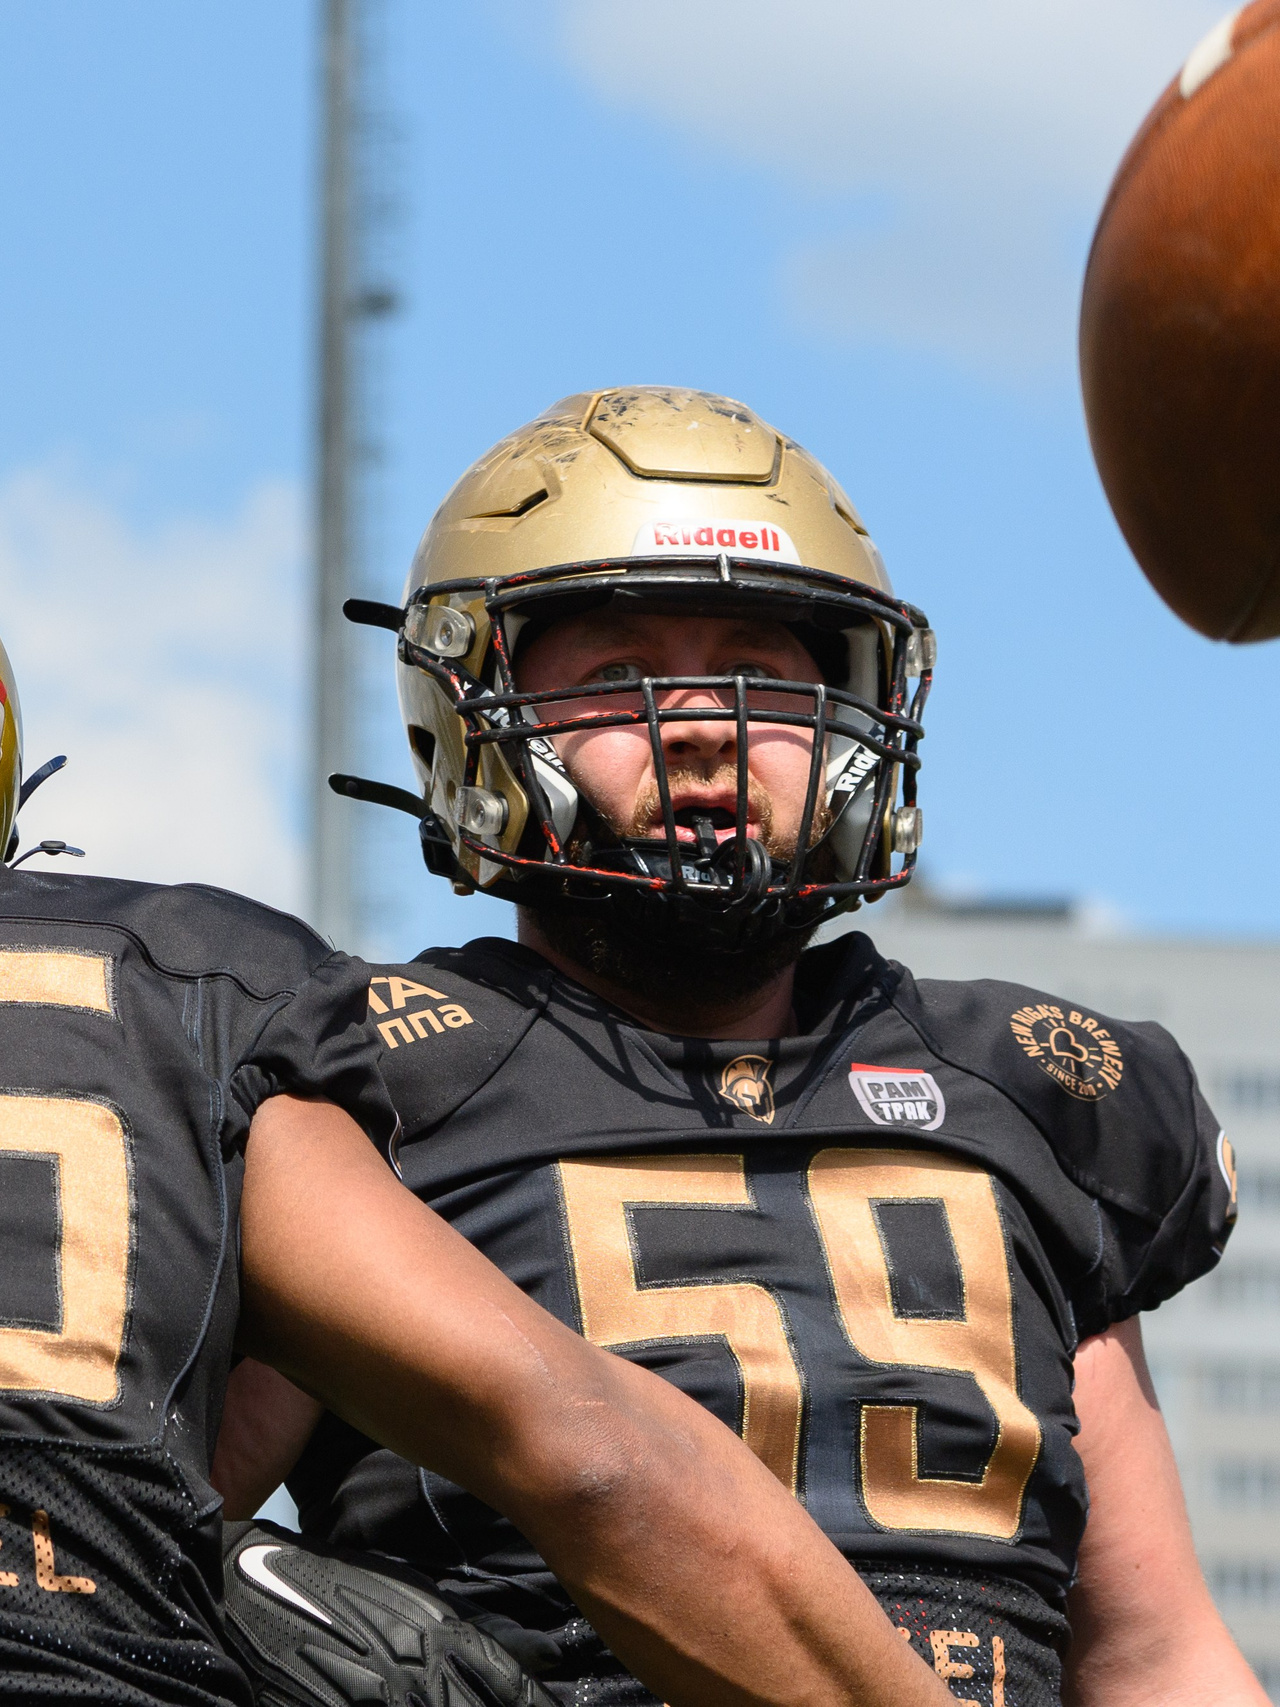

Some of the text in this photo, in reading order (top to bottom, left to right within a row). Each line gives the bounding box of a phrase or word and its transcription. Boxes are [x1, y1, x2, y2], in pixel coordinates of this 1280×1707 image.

[655, 522, 780, 551] Riddell
[1009, 1020, 1046, 1059] NEW
[1068, 1010, 1124, 1091] BREWERY
[1046, 1062, 1077, 1091] SINCE
[557, 1148, 1043, 1540] 59
